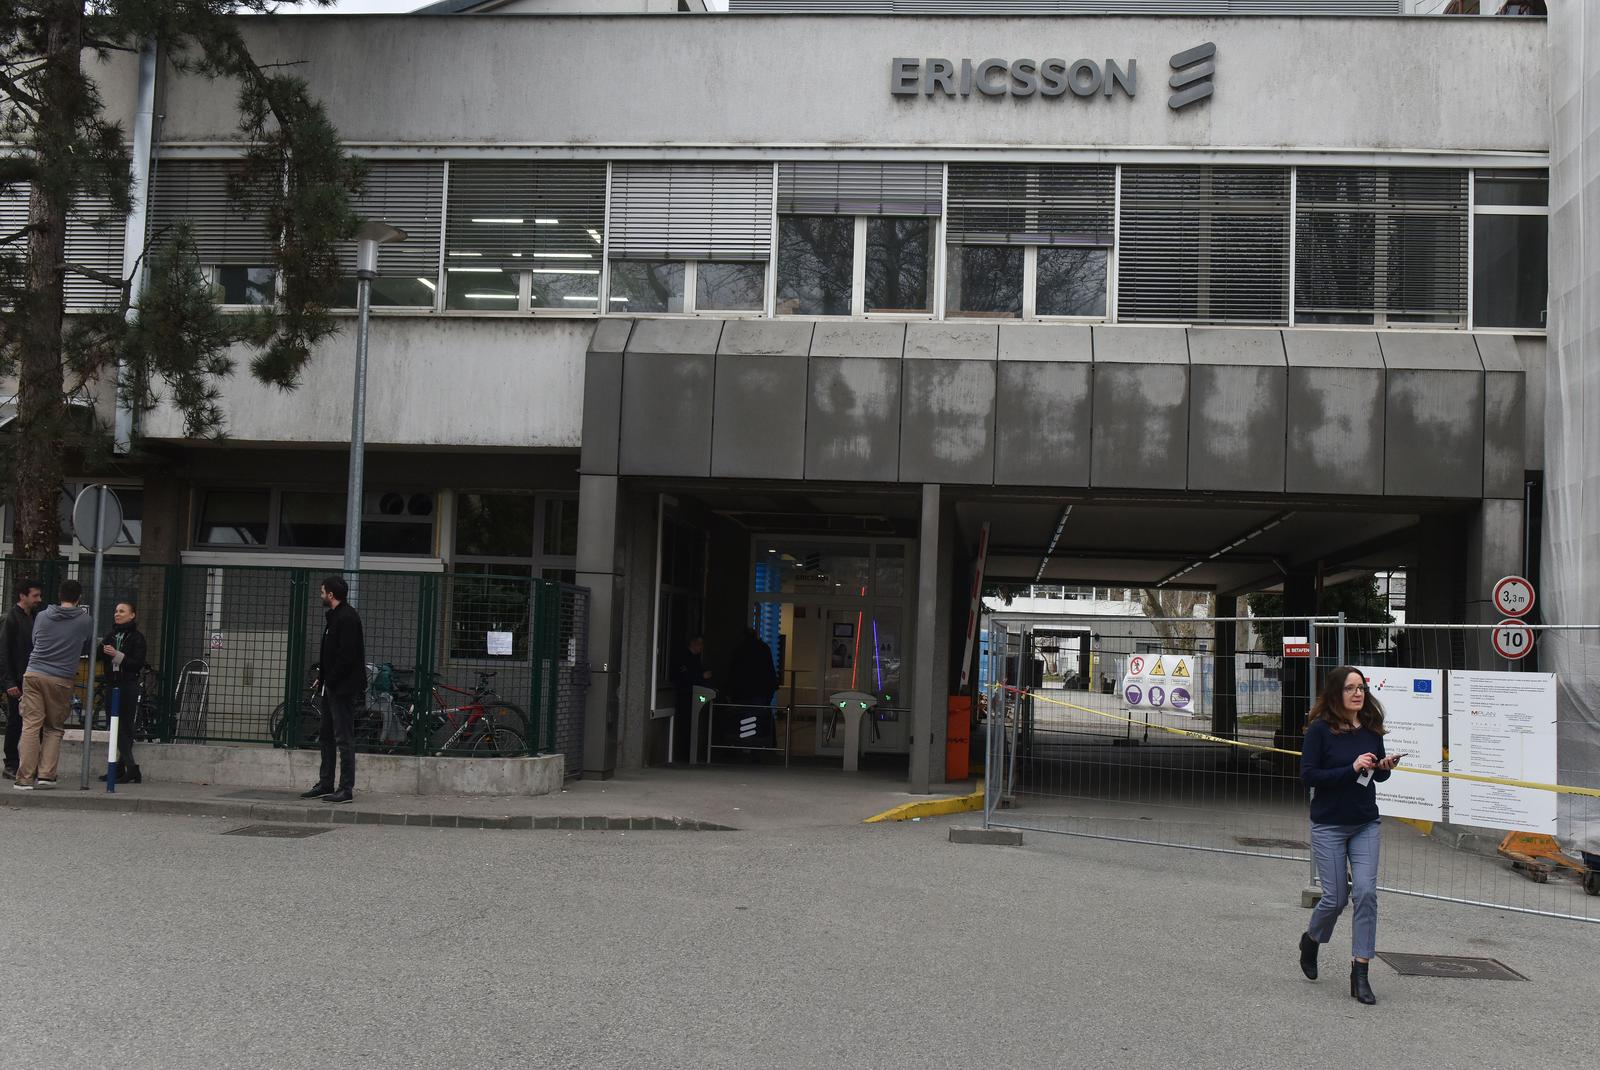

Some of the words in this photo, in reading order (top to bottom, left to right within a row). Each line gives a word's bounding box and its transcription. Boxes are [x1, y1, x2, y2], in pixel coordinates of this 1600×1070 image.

[891, 57, 1137, 98] ERICSSON
[1503, 590, 1517, 604] 3,3
[1503, 632, 1523, 647] 10
